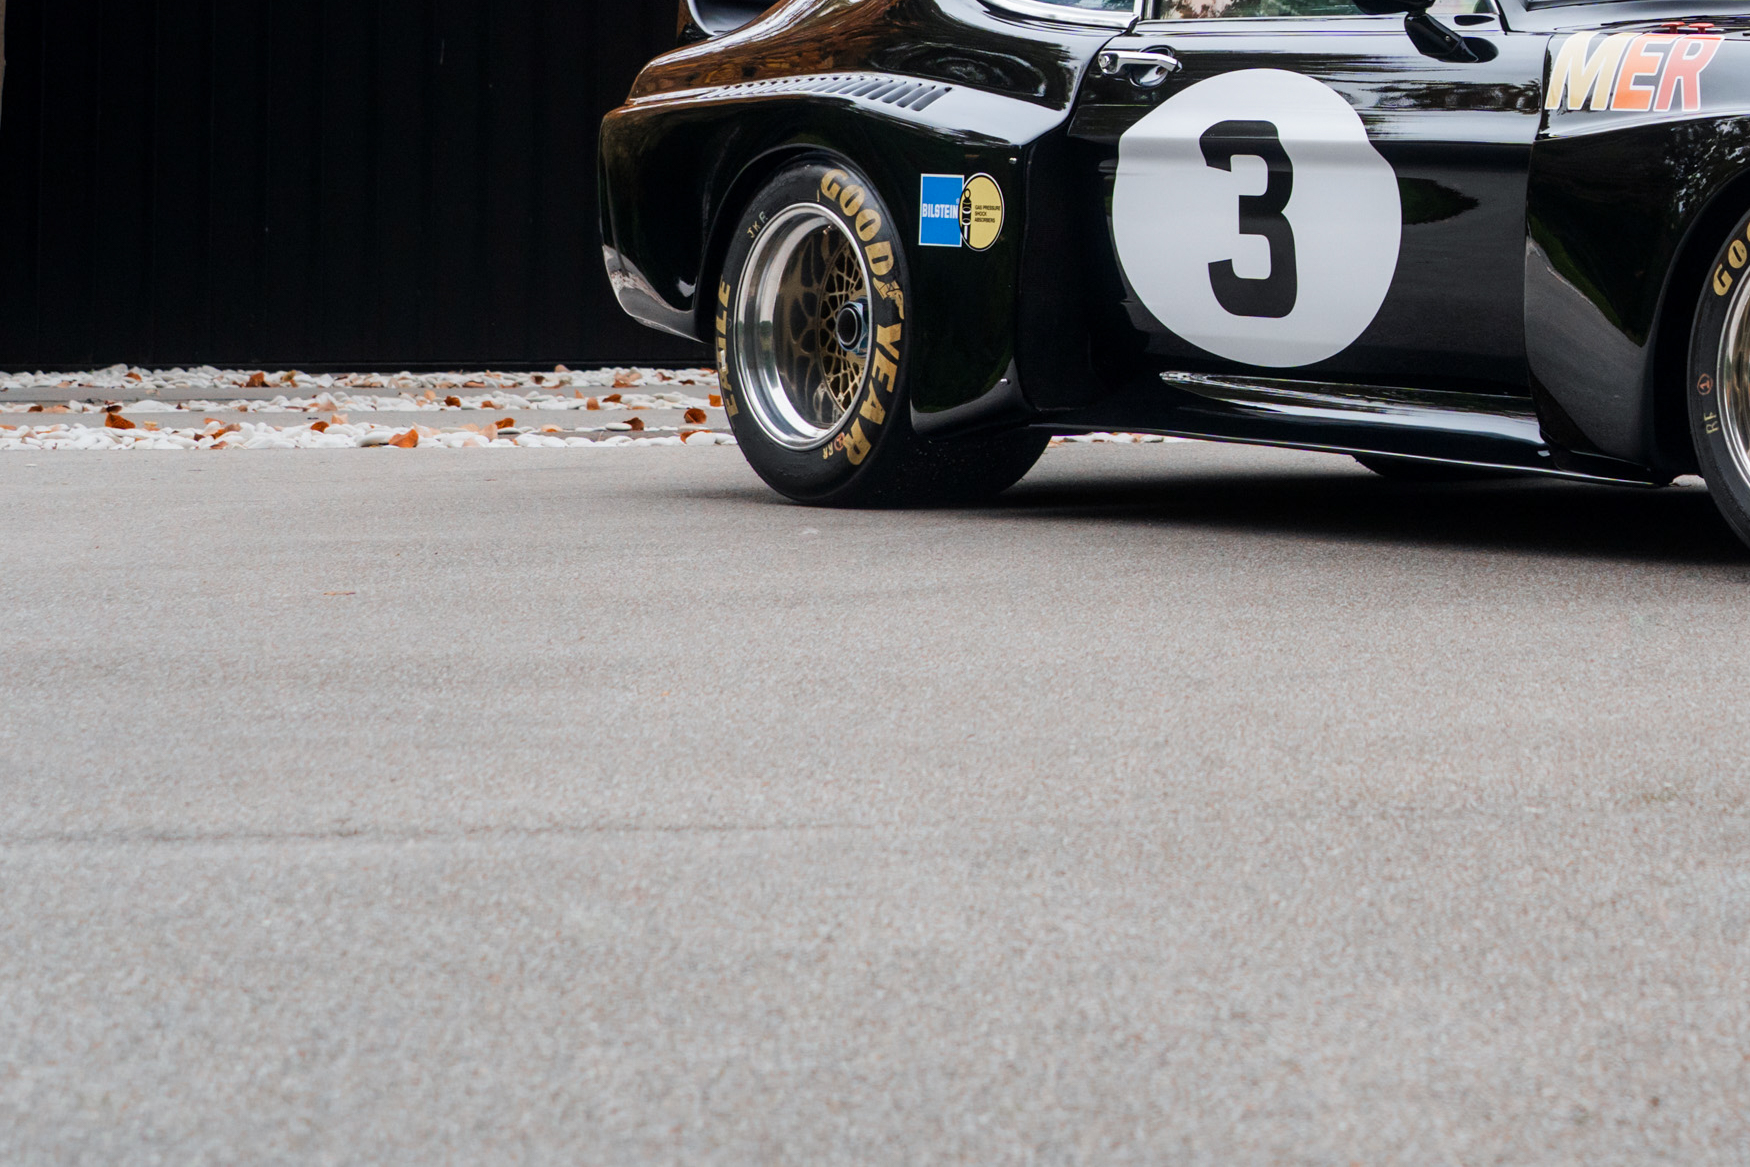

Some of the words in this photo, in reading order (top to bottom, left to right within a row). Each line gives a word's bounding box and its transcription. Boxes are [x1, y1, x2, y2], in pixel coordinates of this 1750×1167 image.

[1544, 31, 1726, 113] MER
[922, 202, 959, 220] BILSTEIN
[1199, 119, 1298, 319] 3
